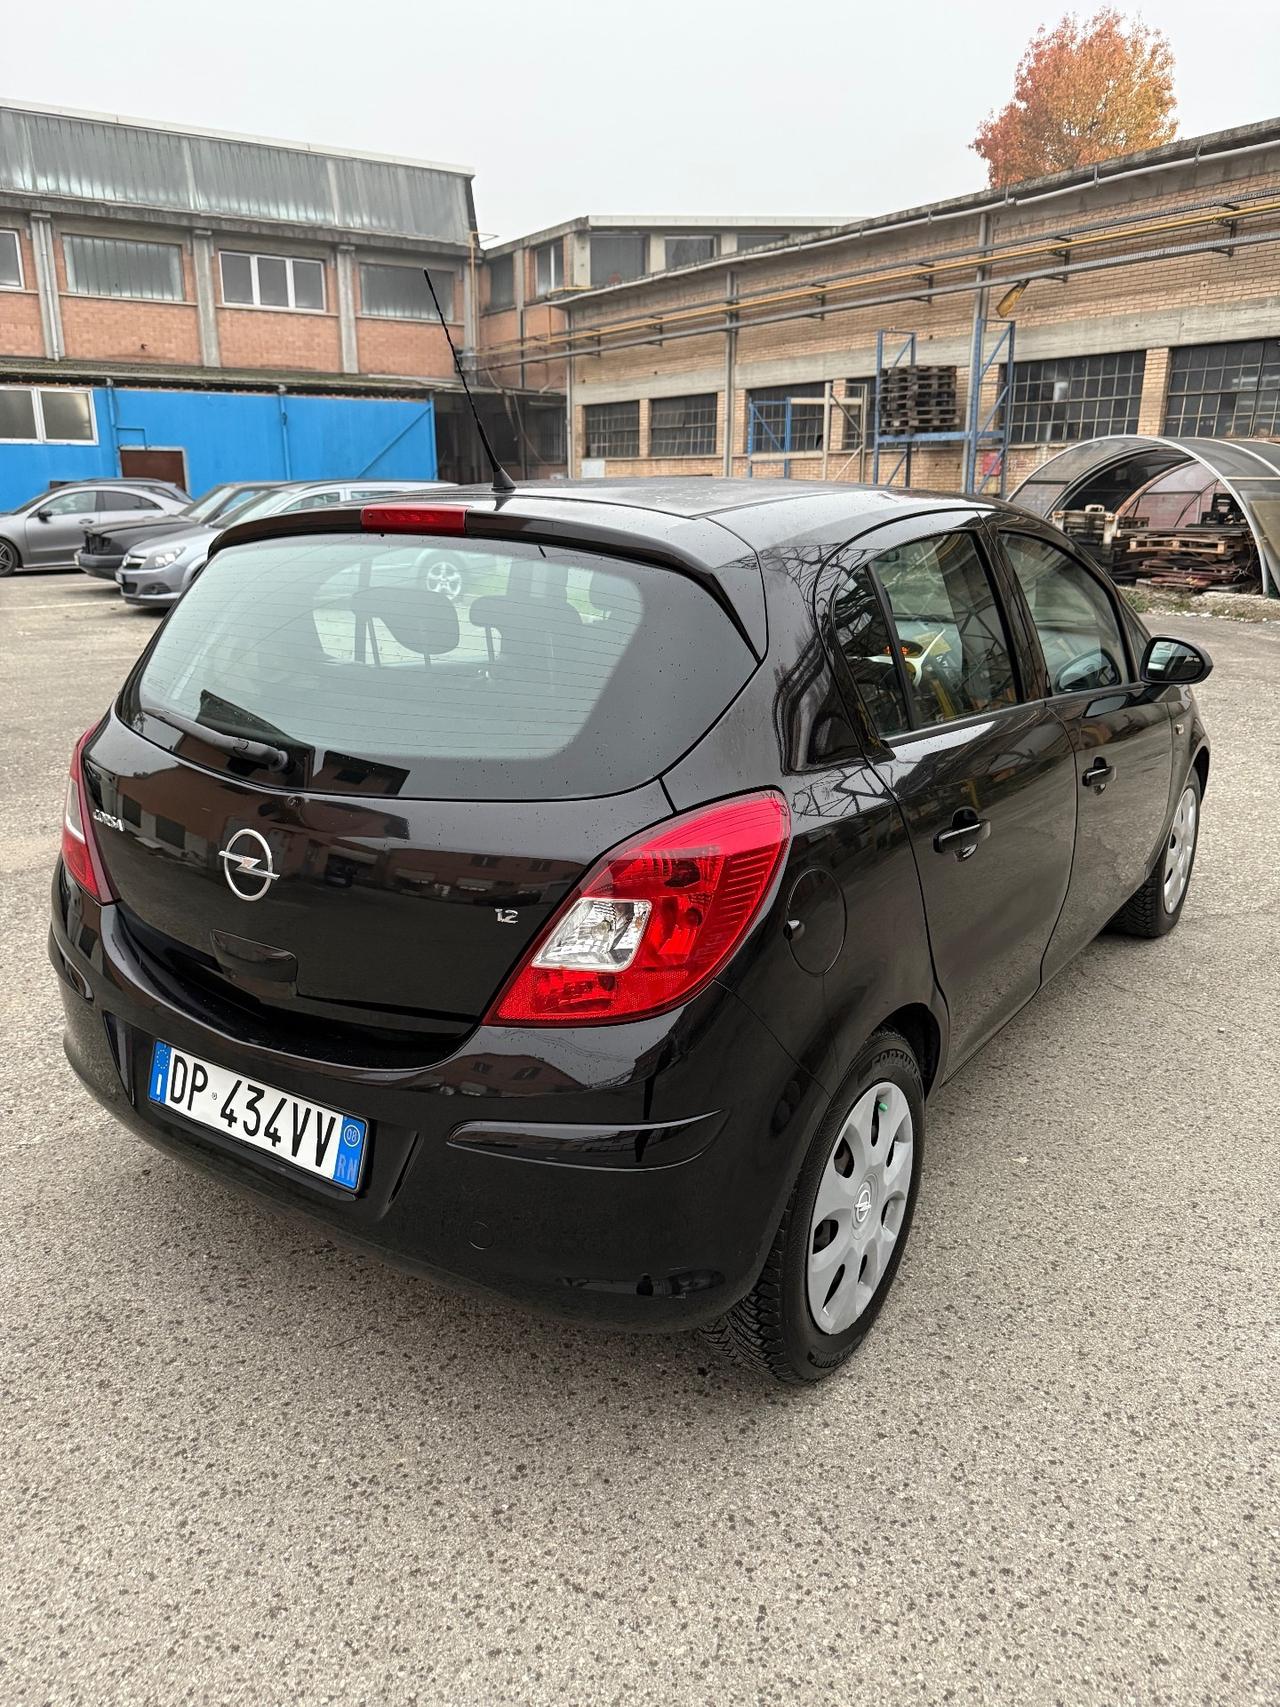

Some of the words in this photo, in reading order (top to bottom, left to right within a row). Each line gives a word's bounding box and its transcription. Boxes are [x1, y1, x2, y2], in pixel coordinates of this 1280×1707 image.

[156, 1073, 162, 1095] I
[170, 1054, 208, 1110] DP
[220, 1080, 336, 1167] 434VV
[346, 1129, 358, 1143] 08
[337, 1154, 358, 1183] RN
